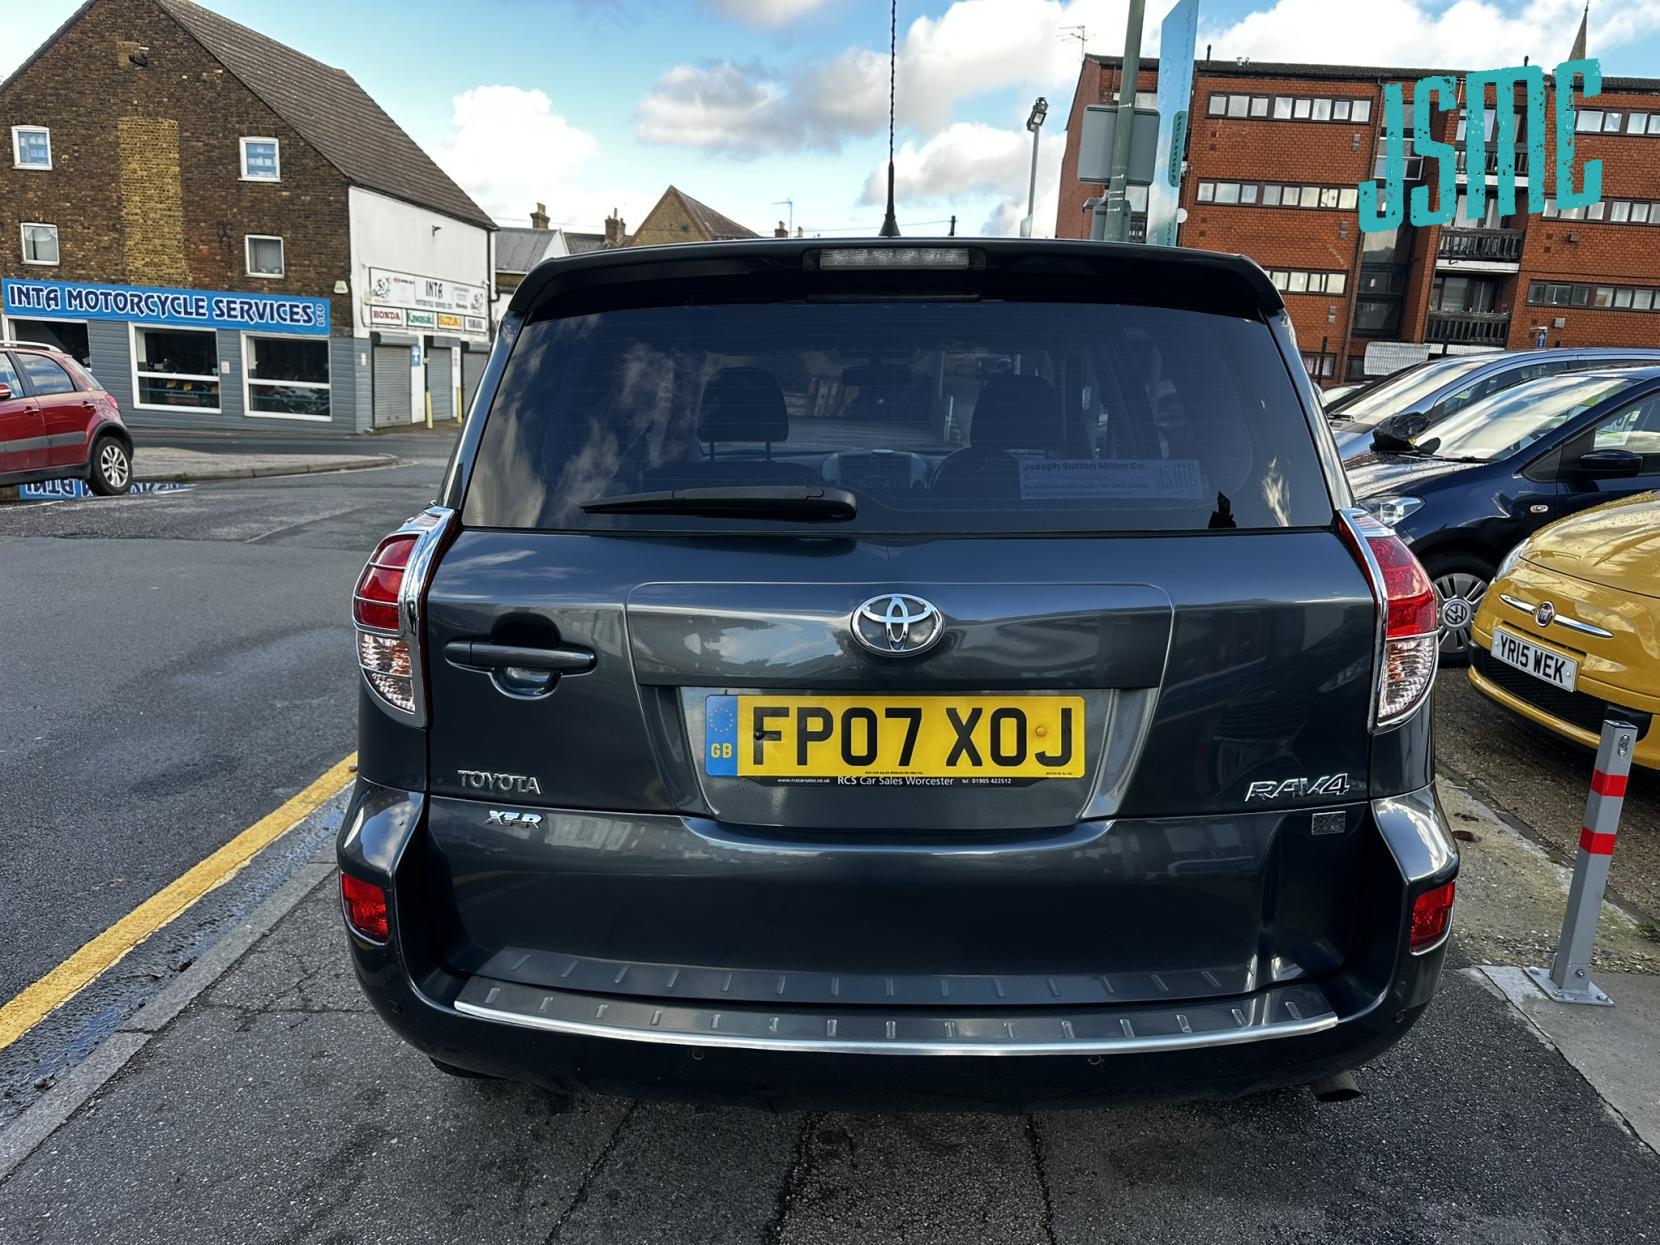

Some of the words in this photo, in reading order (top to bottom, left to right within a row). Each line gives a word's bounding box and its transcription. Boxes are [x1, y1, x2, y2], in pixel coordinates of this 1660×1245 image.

[425, 280, 444, 300] INTA
[8, 284, 61, 311] INTA
[66, 288, 207, 319] MOTORCYCLE
[212, 297, 316, 326] SERVICES
[316, 304, 326, 327] LTD
[373, 310, 401, 320] HONDA
[1023, 462, 1060, 473] Joseph
[1062, 462, 1096, 471] Sutton
[1098, 462, 1129, 471] Motor
[1500, 634, 1530, 668] YR15
[1533, 649, 1566, 684] WEK
[753, 706, 922, 767] FP07
[945, 706, 1073, 767] XOJ
[711, 743, 732, 758] GB
[457, 769, 541, 796] TOYOTA
[837, 776, 857, 785] RCS
[859, 776, 876, 785] Car
[879, 775, 903, 785] Sales
[905, 776, 954, 785] Worcester
[1244, 773, 1350, 802] RAV4
